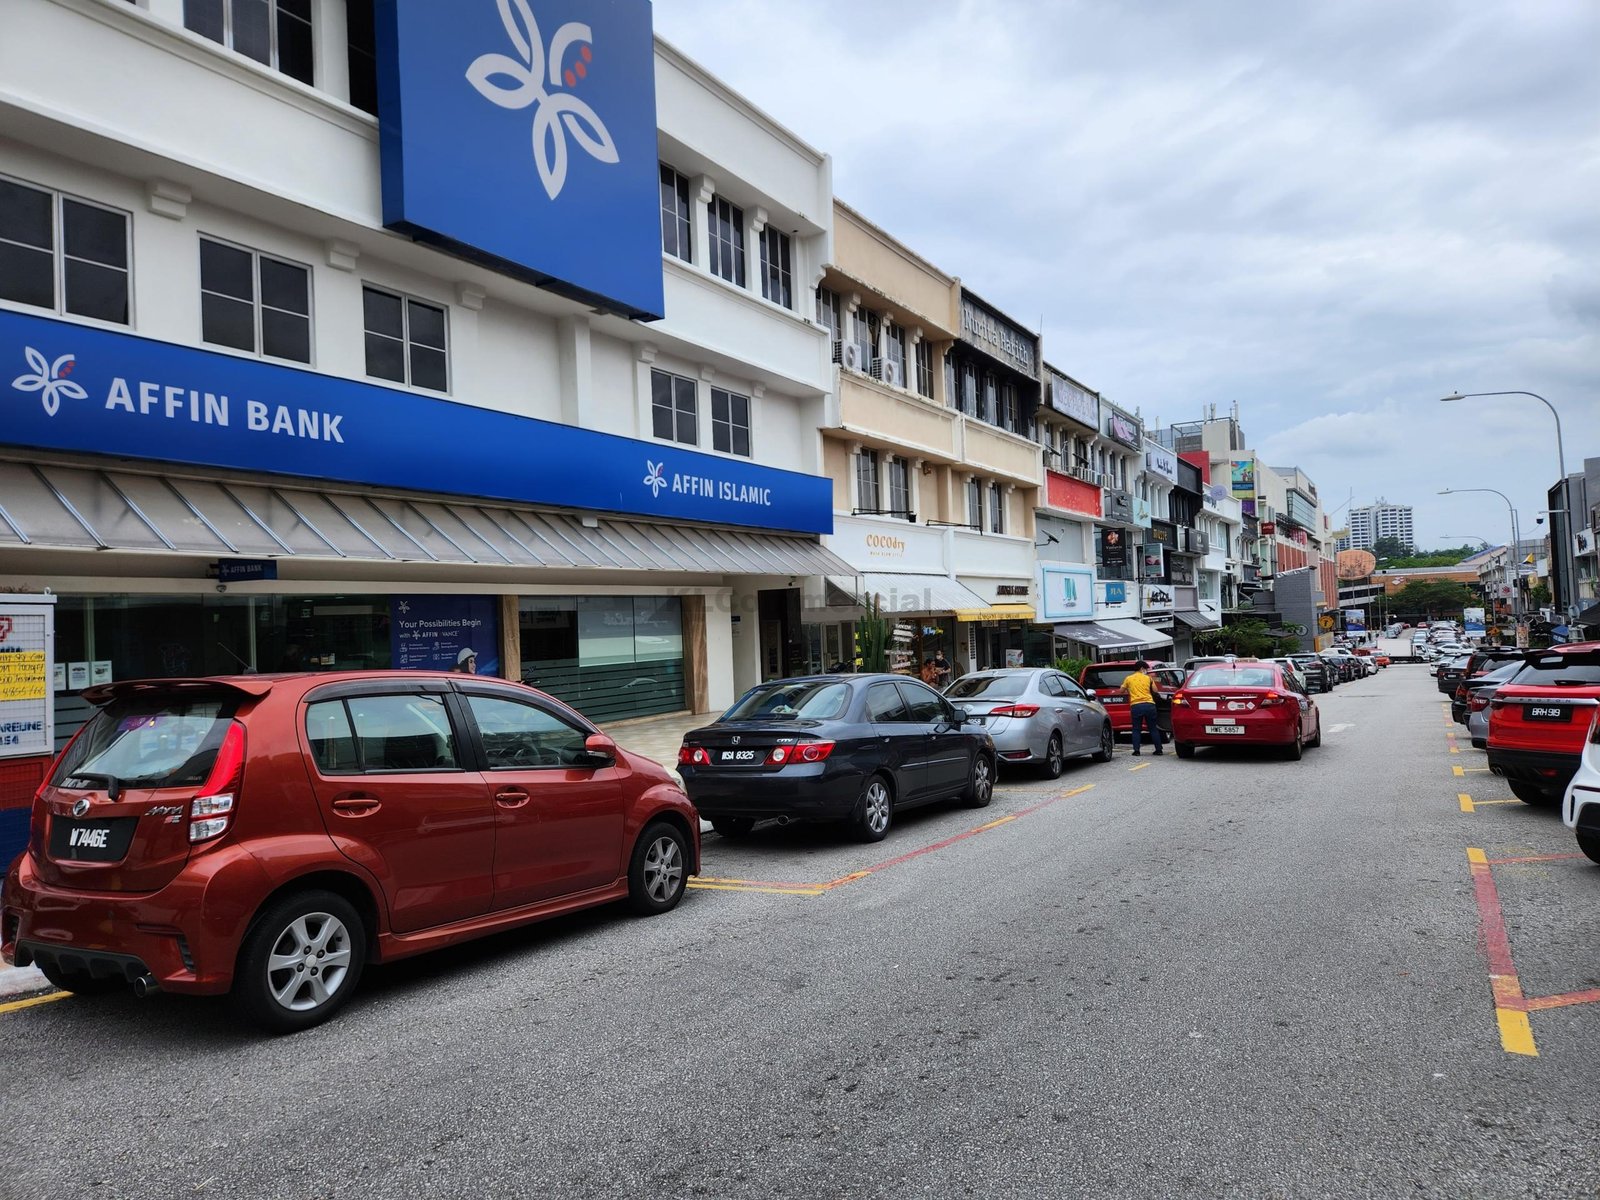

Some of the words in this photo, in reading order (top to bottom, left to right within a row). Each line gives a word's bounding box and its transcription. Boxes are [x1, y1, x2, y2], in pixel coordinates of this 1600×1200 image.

[105, 377, 229, 427] AFFIN
[247, 399, 345, 443] BANK
[672, 473, 714, 498] AFFIN
[719, 481, 771, 506] ISLAMIC
[230, 565, 246, 574] AFFIN
[246, 564, 263, 572] BANK
[399, 620, 417, 628] Your
[419, 619, 461, 628] Possibilities
[462, 618, 481, 628] Begin
[1532, 707, 1548, 716] BRH
[735, 750, 755, 760] 8325
